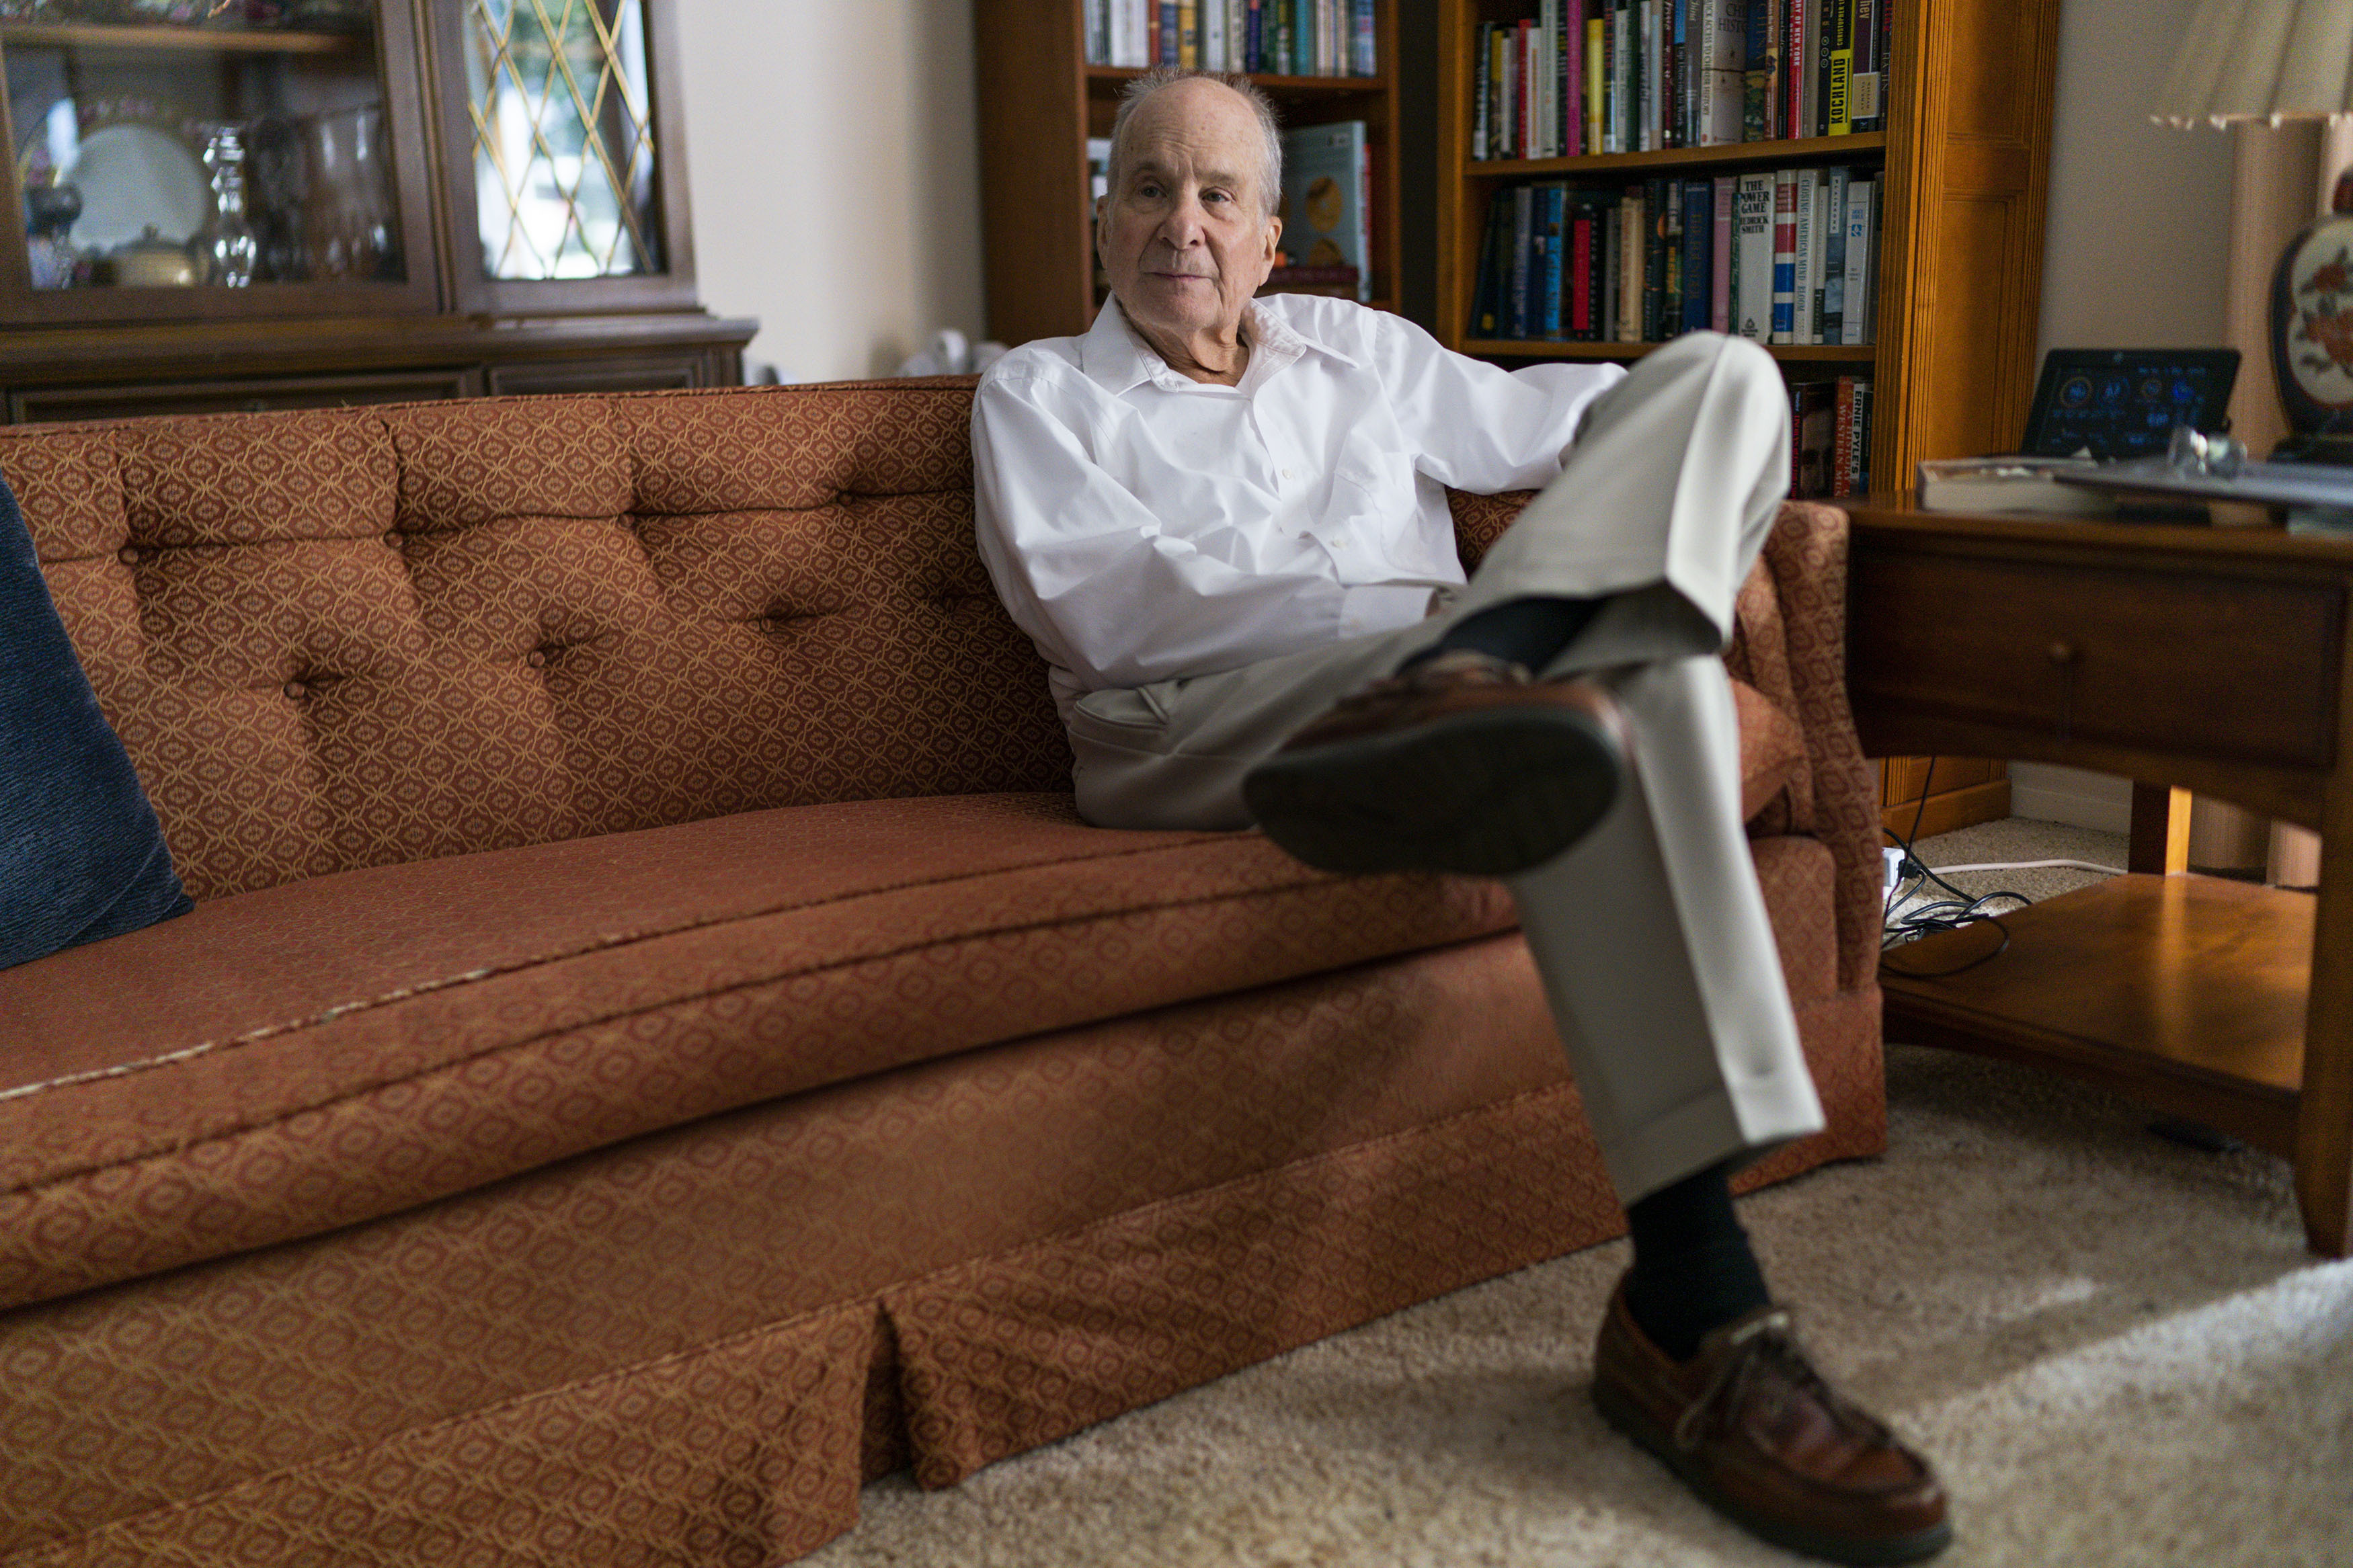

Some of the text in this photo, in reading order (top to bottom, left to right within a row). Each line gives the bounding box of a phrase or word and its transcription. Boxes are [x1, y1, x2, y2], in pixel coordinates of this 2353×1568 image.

[1836, 5, 1845, 47] CHRISTOPHER
[1831, 58, 1846, 124] KOCHLAND
[1745, 180, 1764, 191] THE
[1800, 179, 1810, 213] CLOSING
[1741, 202, 1767, 214] GAME
[1741, 224, 1765, 233] SMITH
[1798, 217, 1810, 257] AMERICAN
[1798, 259, 1808, 281] MIND
[1796, 286, 1807, 312] BLOOM
[1836, 404, 1847, 464] WESTERN
[1851, 390, 1862, 474] ERNIE PYLE'S
[1844, 425, 1853, 482] HISTORY
